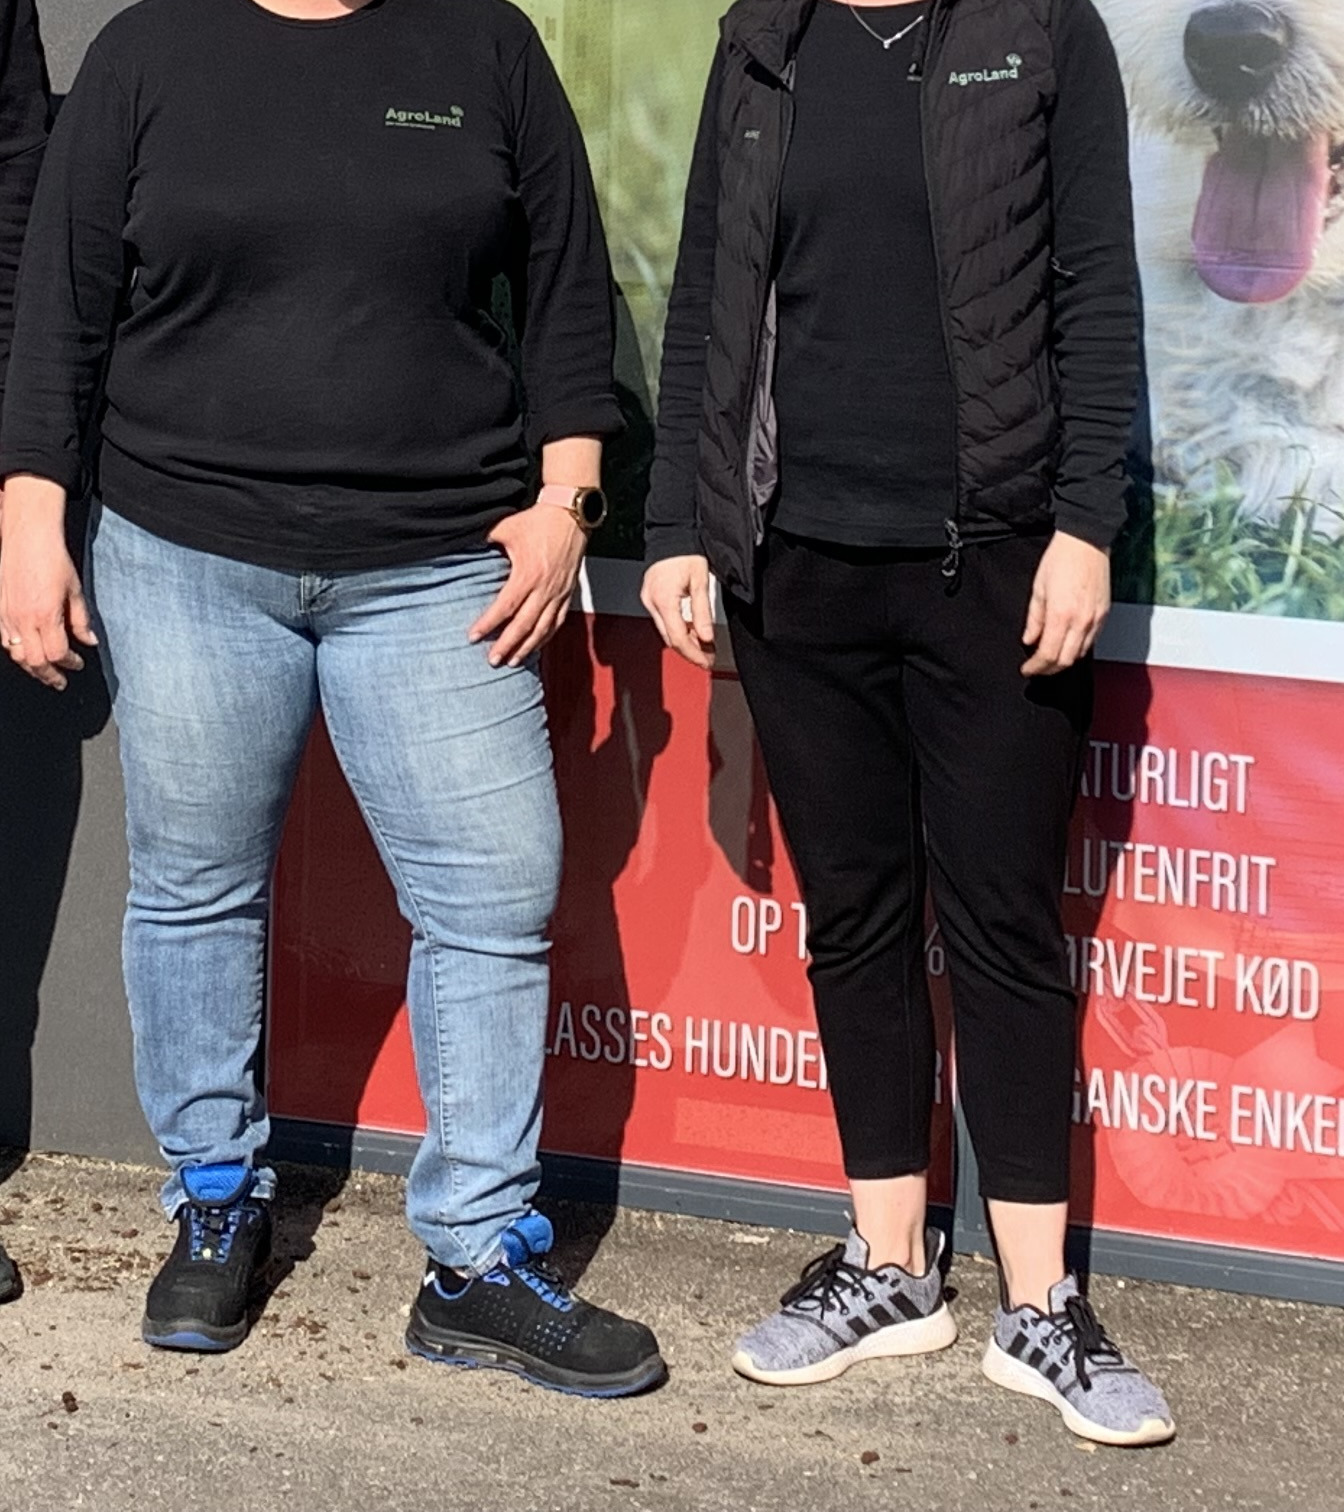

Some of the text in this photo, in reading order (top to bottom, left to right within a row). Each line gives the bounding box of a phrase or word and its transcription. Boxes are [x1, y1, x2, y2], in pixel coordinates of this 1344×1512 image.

[948, 67, 1019, 86] AgroLand
[385, 107, 462, 128] AgroLand
[1080, 740, 1255, 814] TURLIGT
[1062, 837, 1277, 916] LUTENFRIT
[731, 895, 783, 956] OP
[1235, 954, 1320, 1021] KØD
[545, 1000, 673, 1071] ASSES
